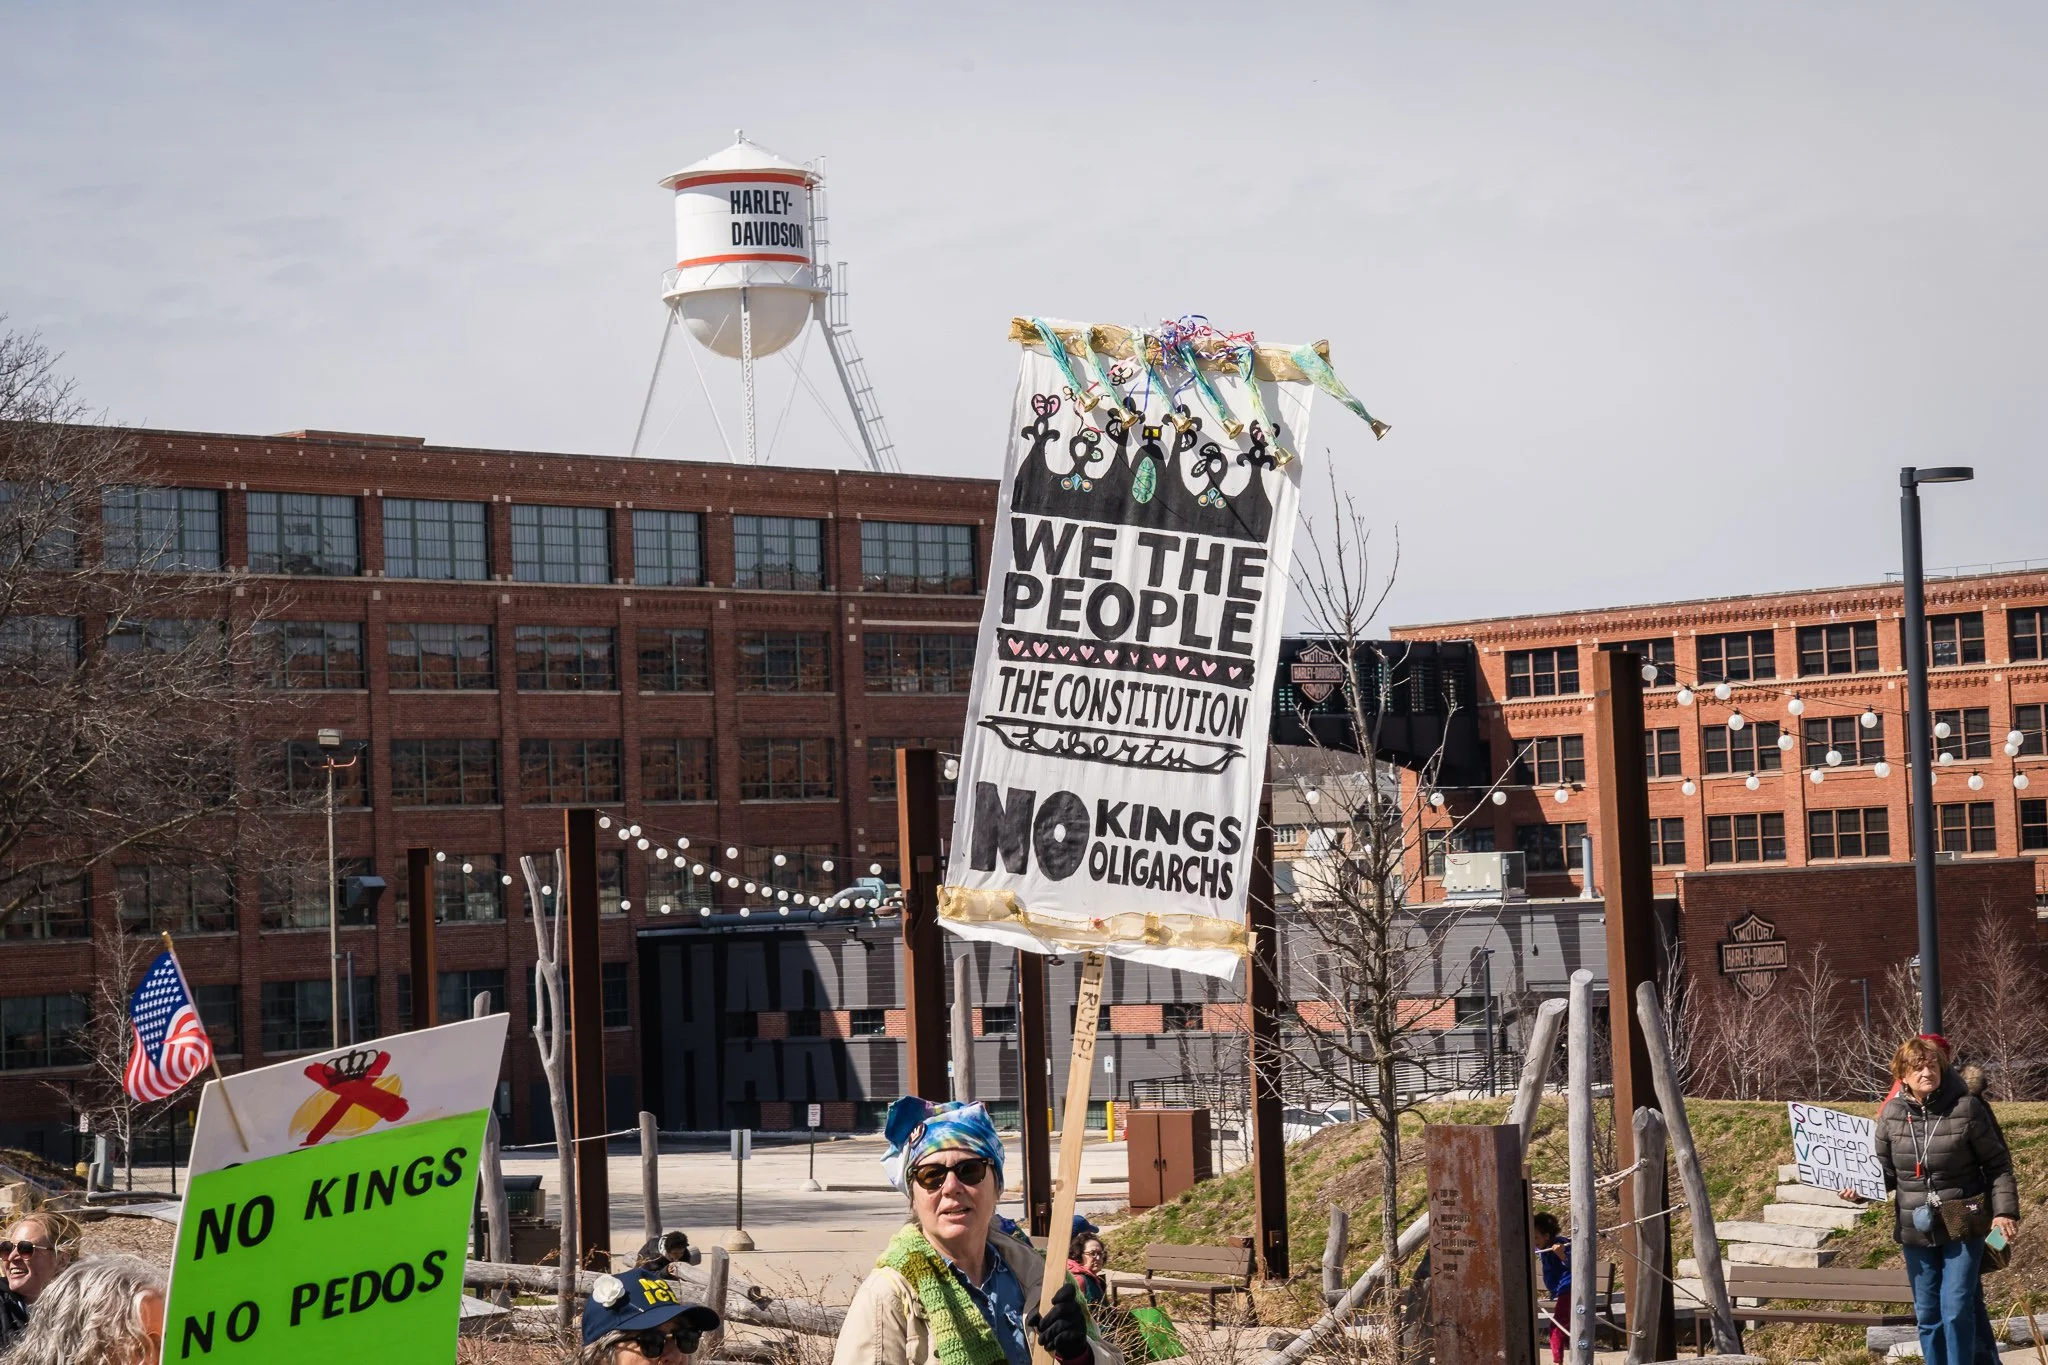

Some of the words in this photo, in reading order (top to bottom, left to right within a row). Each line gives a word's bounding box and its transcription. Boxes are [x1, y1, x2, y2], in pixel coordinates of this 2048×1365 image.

[730, 190, 793, 215] HARLEY-
[731, 221, 804, 249] DAVIDSON
[1010, 516, 1118, 581] WE
[1137, 530, 1268, 602] THE
[1001, 571, 1257, 655] PEOPLE
[998, 666, 1053, 715] THE
[1053, 673, 1250, 740] CONSTITUTION
[969, 780, 1091, 882] NO
[1094, 798, 1243, 856] KINGS
[1088, 840, 1234, 900] OLIGARCHS
[1738, 920, 1770, 942] MOTOR
[1791, 1103, 1870, 1137] SCREW
[1793, 1122, 1870, 1155] American
[1795, 1142, 1882, 1178] VOTERS
[1798, 1163, 1886, 1201] EVERYWHERE
[193, 1194, 275, 1261] NO
[303, 1147, 468, 1221] KINGS
[638, 1278, 669, 1291] NO
[181, 1300, 260, 1360] NO
[289, 1250, 448, 1327] PEDOS
